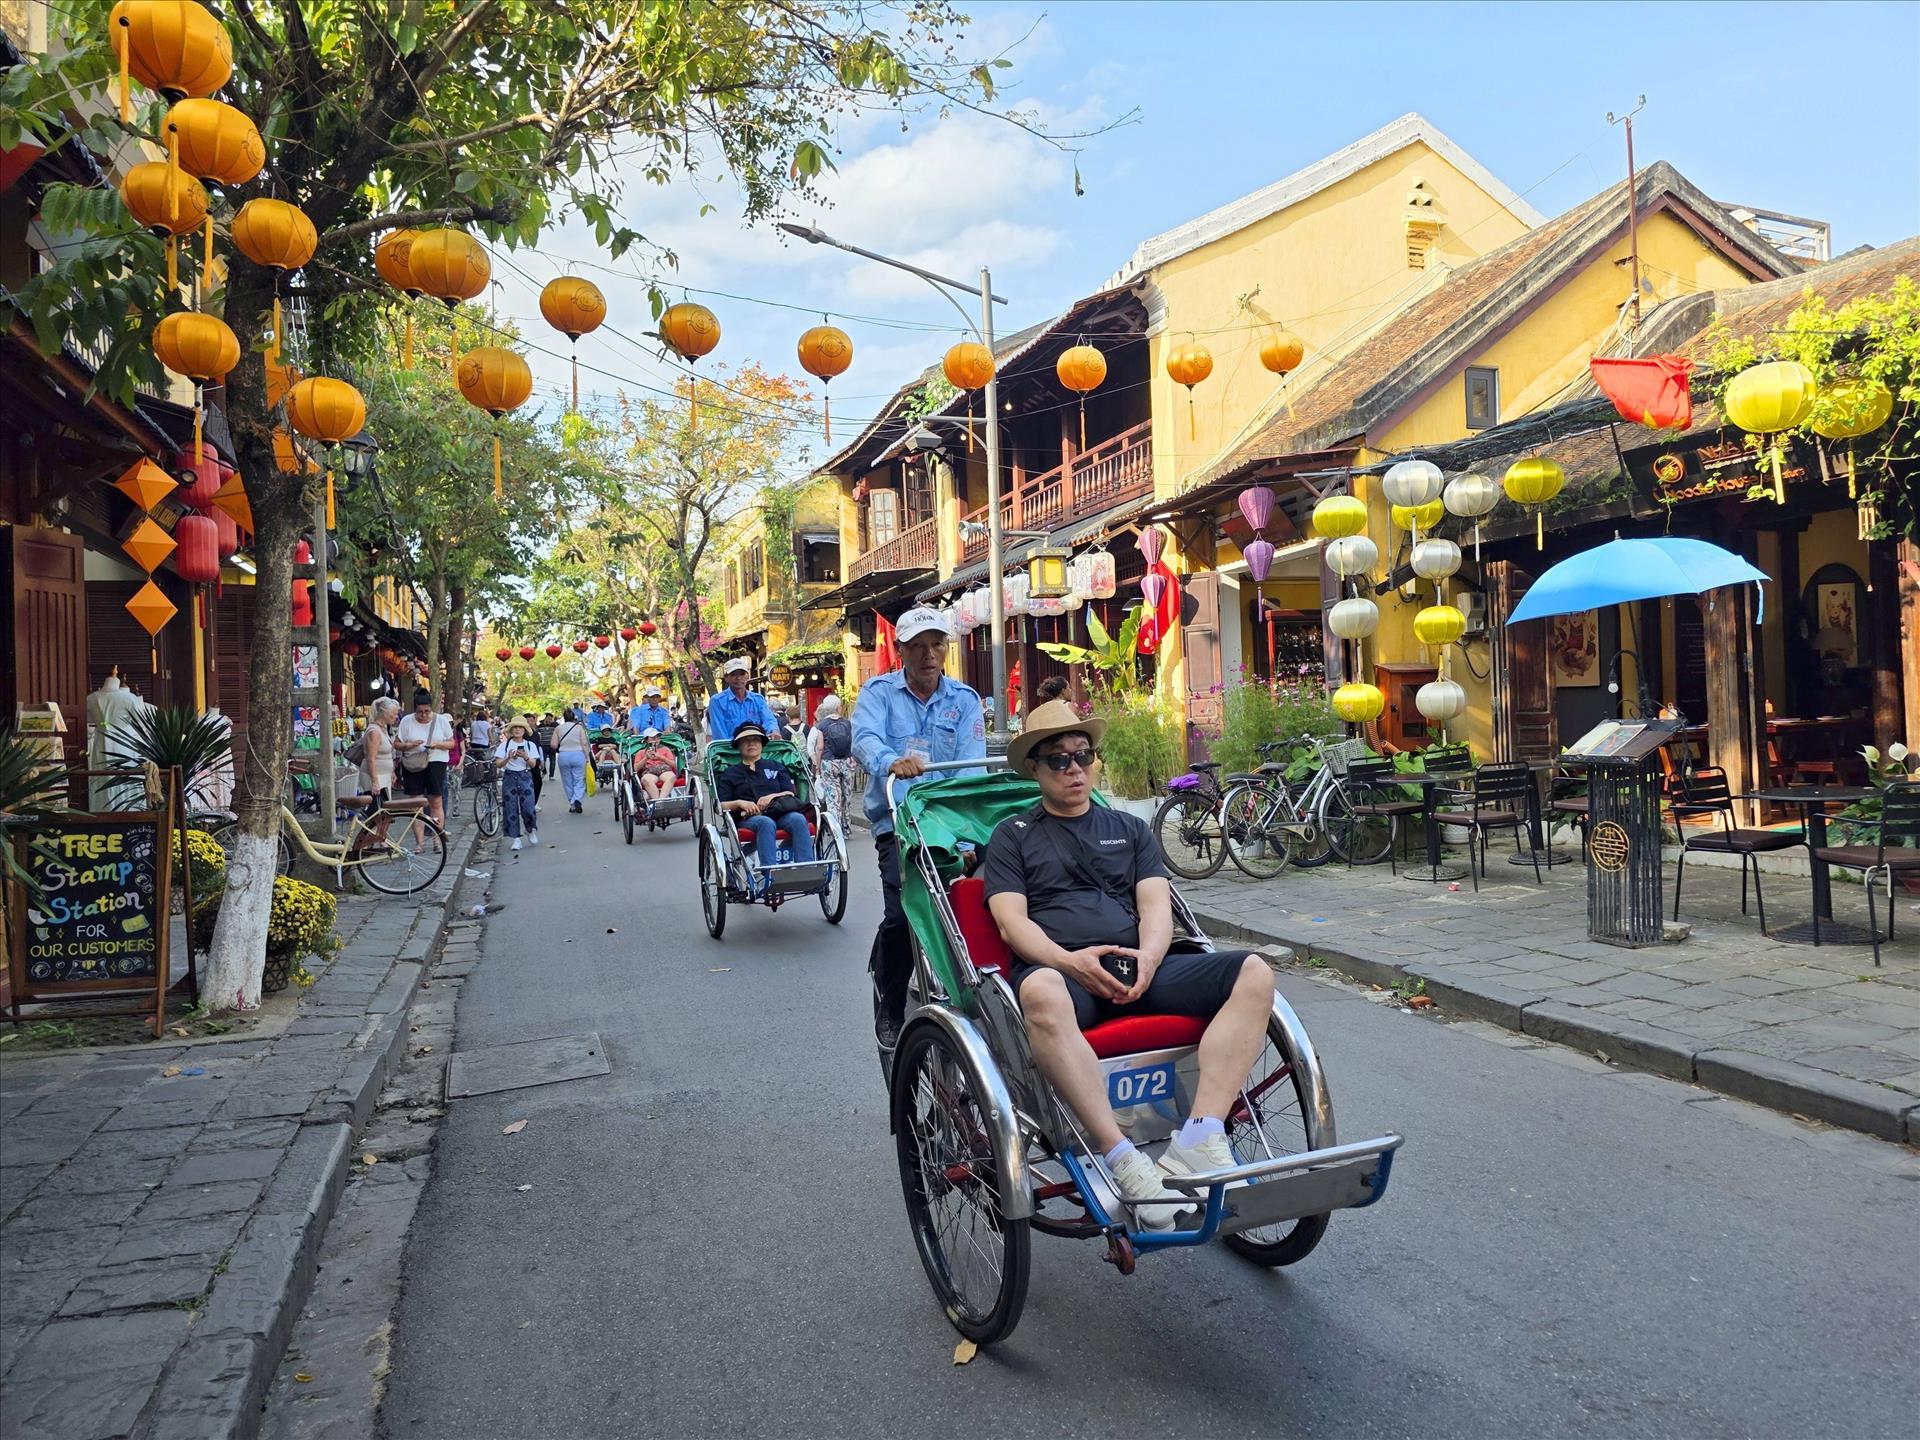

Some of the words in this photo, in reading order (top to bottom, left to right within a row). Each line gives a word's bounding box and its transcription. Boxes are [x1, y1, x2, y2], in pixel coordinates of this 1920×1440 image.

[771, 673, 790, 681] MART
[61, 833, 123, 859] FREE
[40, 861, 133, 891] Stamp
[47, 891, 145, 924] Station
[76, 924, 108, 937] FOR
[30, 944, 63, 957] OUR
[68, 939, 155, 956] CUSTOMERS
[1117, 1070, 1167, 1101] 072
